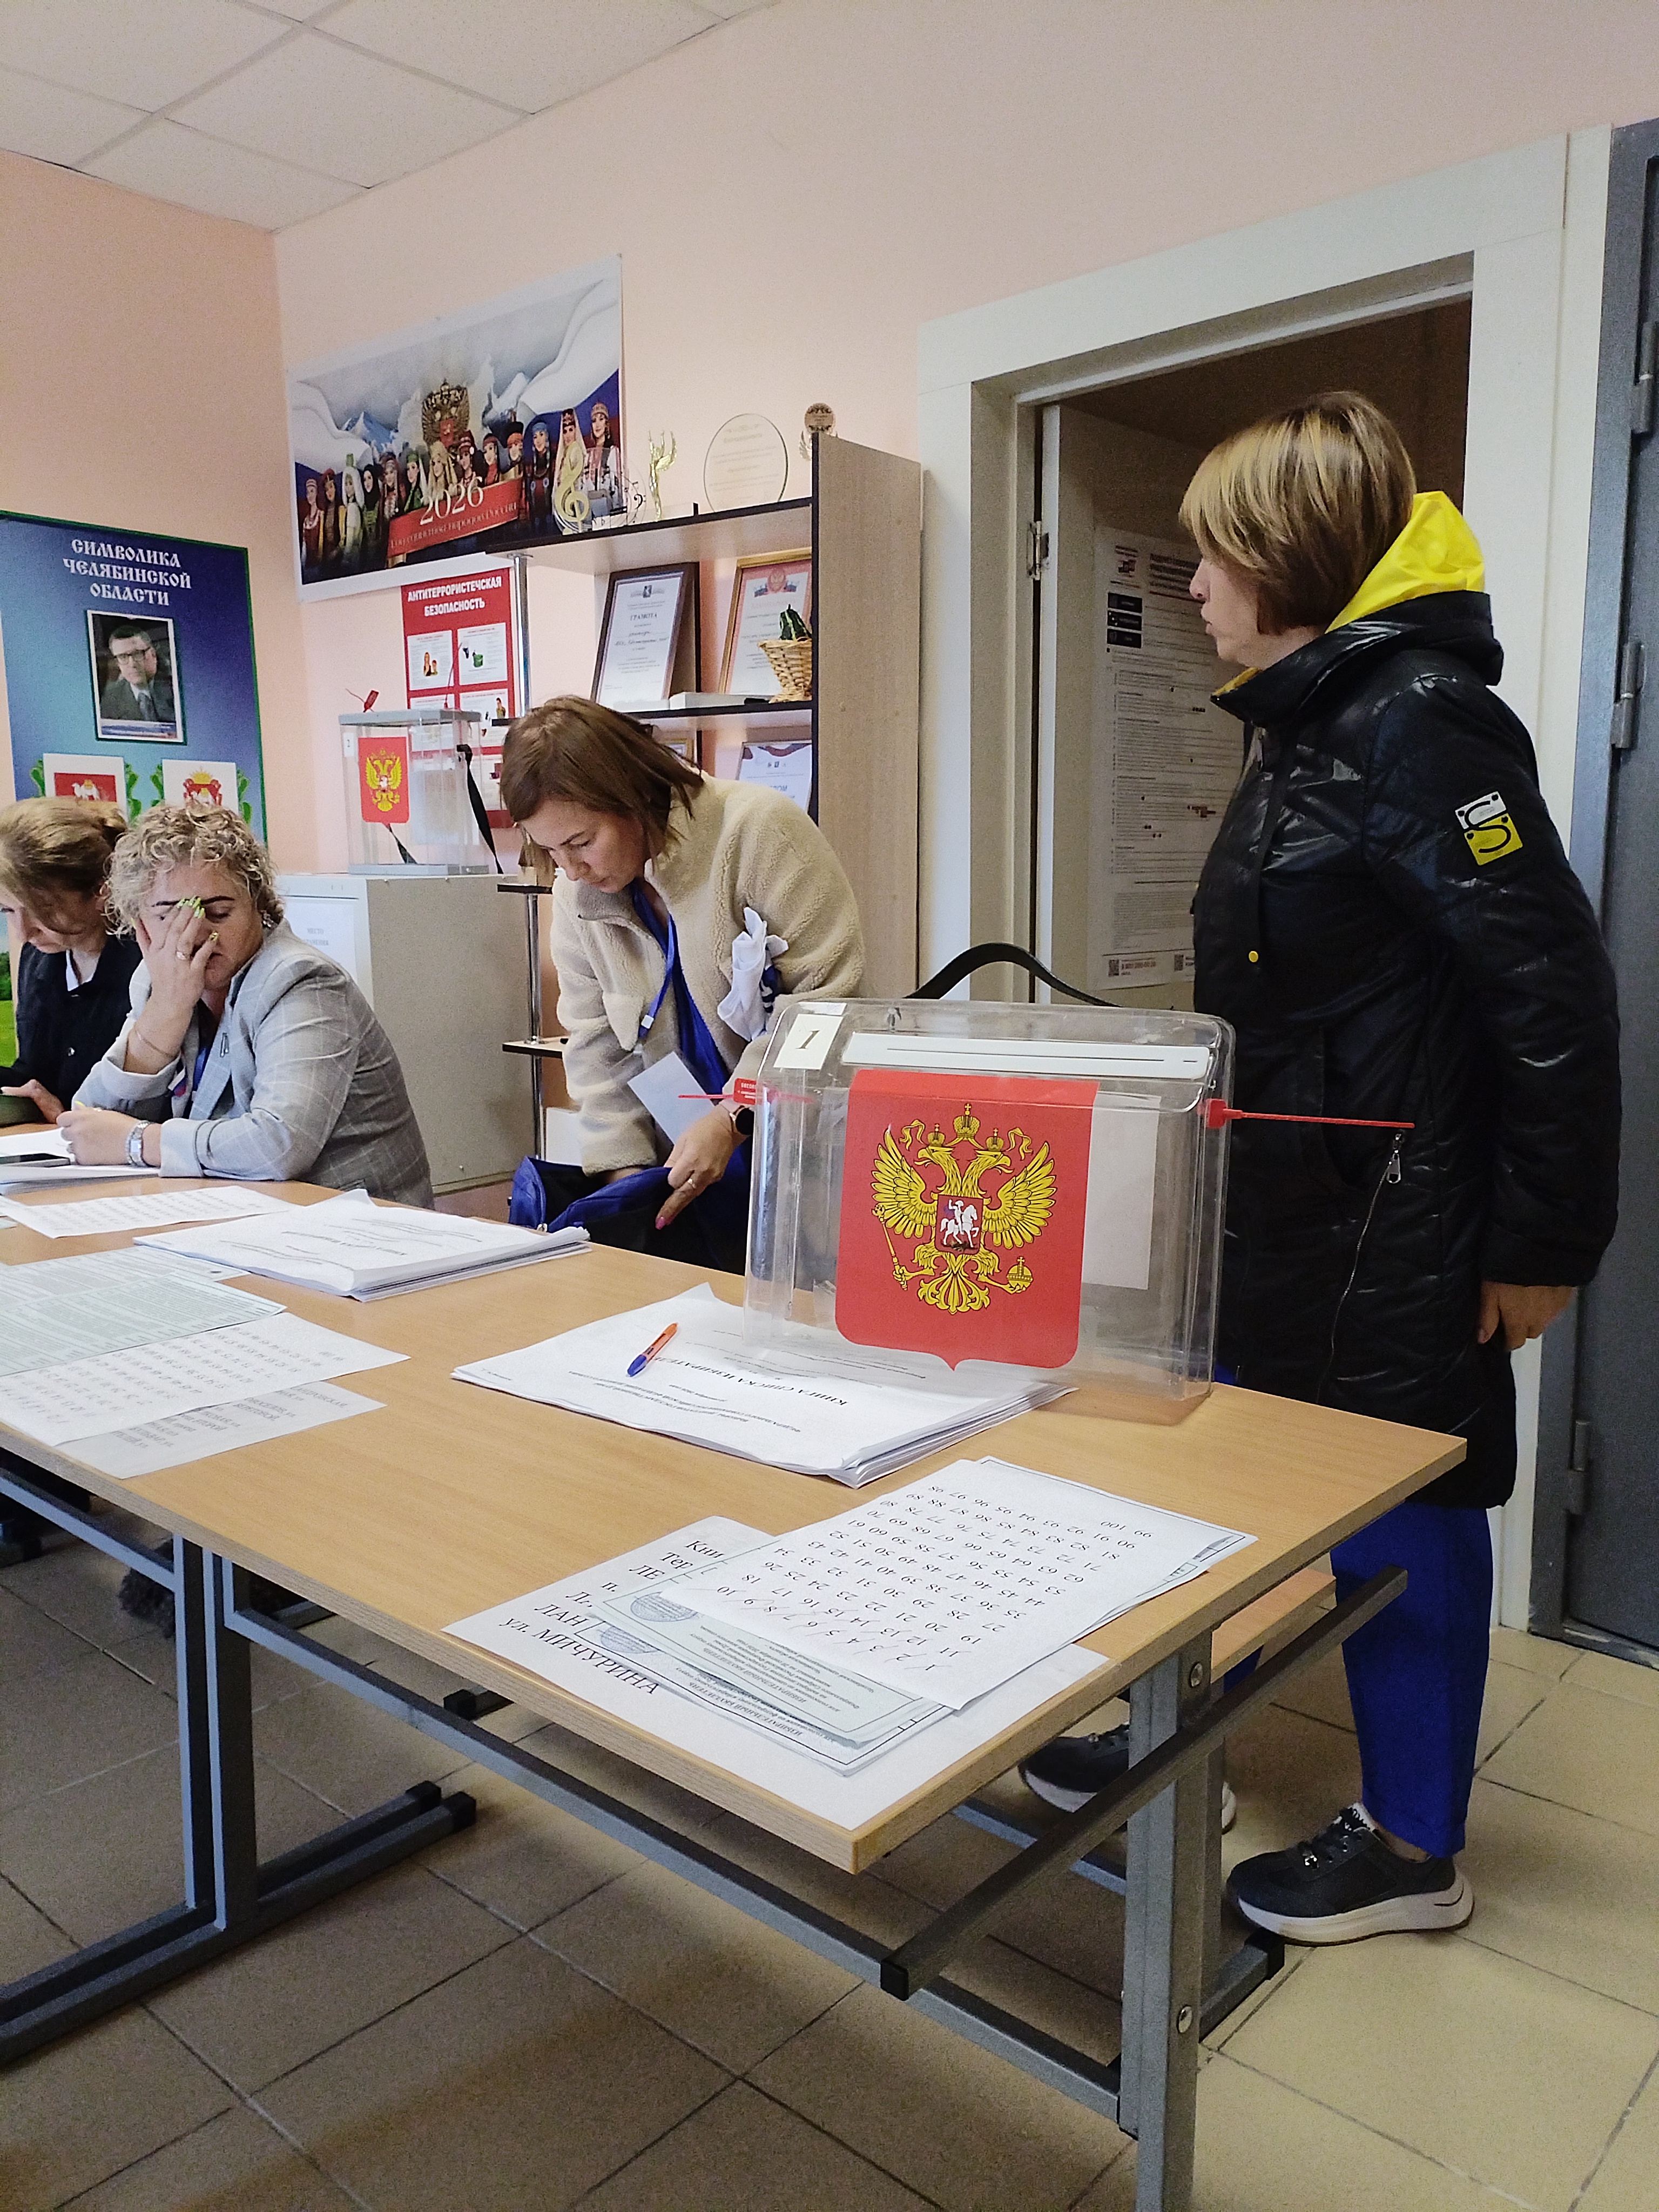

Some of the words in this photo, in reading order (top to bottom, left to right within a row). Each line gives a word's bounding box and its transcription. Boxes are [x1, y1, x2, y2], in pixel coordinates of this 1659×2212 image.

[420, 476, 484, 525] 2026
[71, 539, 181, 567] СИМВОЛИКА
[63, 558, 192, 589] ЧЕЛЯБИНСКОЙ
[90, 582, 169, 606] ОБЛАСТИ
[424, 597, 485, 617] БЕЗОПАСНОСТЬ
[797, 1030, 820, 1049] 1
[653, 1356, 736, 1380] ИЗБИРАТЕЛ
[737, 1378, 794, 1392] СПИСКА
[798, 1390, 848, 1406] КНИГА
[905, 1507, 922, 1515] 78
[1019, 1513, 1035, 1521] 94
[911, 1526, 930, 1534] 68
[956, 1524, 972, 1532] 76
[1067, 1526, 1083, 1534] 92
[1101, 1521, 1126, 1530] 100
[830, 1530, 849, 1539] 52
[868, 1527, 888, 1535] 60
[1020, 1528, 1040, 1536] 84
[891, 1536, 912, 1545] 59
[977, 1532, 994, 1540] 75
[1046, 1535, 1064, 1543] 83
[1094, 1533, 1109, 1541] 91
[853, 1539, 872, 1548] 51
[1002, 1539, 1020, 1547] 74
[1070, 1542, 1090, 1550] 82
[1117, 1540, 1135, 1549] 90
[685, 1541, 725, 1559] Кни
[774, 1548, 795, 1556] 34
[830, 1549, 849, 1557] 42
[874, 1548, 895, 1556] 50
[914, 1544, 935, 1553] 58
[1027, 1546, 1044, 1554] 73
[938, 1552, 960, 1561] 57
[1056, 1554, 1074, 1563] 72
[1102, 1551, 1120, 1560] 81
[660, 1552, 694, 1569] Тер
[800, 1557, 821, 1566] 33
[854, 1558, 873, 1567] 41
[1011, 1557, 1031, 1566] 64
[763, 1562, 783, 1572] 26
[922, 1564, 942, 1572] 48
[967, 1561, 988, 1570] 56
[1083, 1562, 1102, 1572] 71
[629, 1565, 665, 1580] ЛЕ
[827, 1567, 848, 1577] 32
[876, 1567, 896, 1575] 40
[992, 1569, 1014, 1579] 55
[741, 1575, 761, 1584] 18
[784, 1571, 806, 1581] 25
[901, 1576, 922, 1584] 39
[1063, 1573, 1084, 1583] 62
[807, 1580, 830, 1590] 24
[856, 1578, 876, 1587] 31
[971, 1581, 993, 1589] 46
[1017, 1577, 1040, 1587] 54
[771, 1588, 793, 1597] 17
[883, 1588, 905, 1598] 30
[925, 1584, 948, 1593] 38
[1044, 1586, 1066, 1595] 53
[836, 1591, 858, 1601] 23
[950, 1593, 974, 1602] 37
[997, 1590, 1019, 1598] 45
[799, 1598, 820, 1608] 16
[912, 1599, 935, 1608] 29
[977, 1601, 1000, 1611] 36
[1024, 1597, 1046, 1606] 44
[865, 1601, 887, 1612] 22
[534, 1604, 590, 1627] ЛАН
[824, 1608, 845, 1617] 15
[895, 1612, 918, 1622] 21
[947, 1610, 970, 1620] 28
[1003, 1610, 1027, 1620] 35
[849, 1617, 870, 1627] 14
[925, 1622, 948, 1632] 20
[981, 1623, 1006, 1632] 27
[880, 1628, 901, 1637] 13
[906, 1636, 927, 1645] 12
[961, 1635, 981, 1644] 19
[499, 1618, 527, 1633] ул.
[532, 1629, 660, 1695] МИЧУРИНА
[939, 1647, 961, 1657] 11
[743, 1670, 806, 1703] ИЗБИРАТЕЛЬНЫЙ
